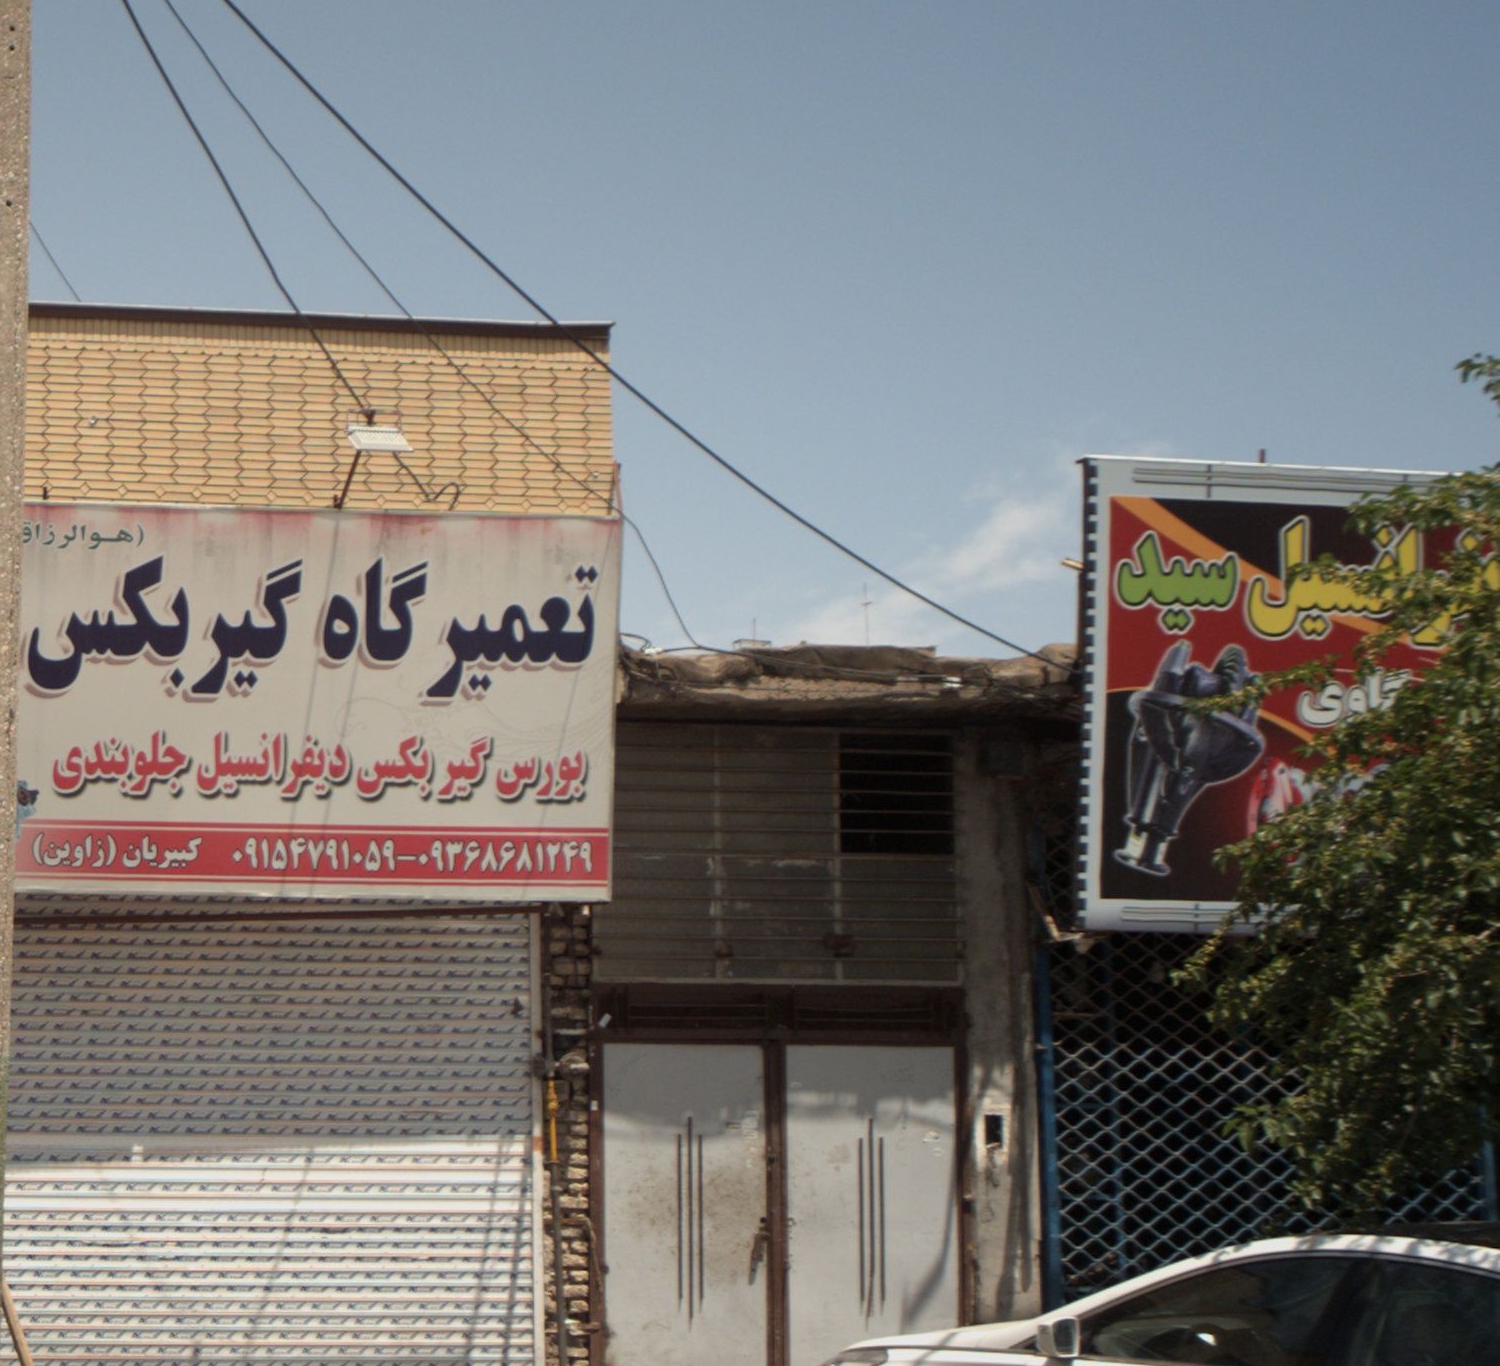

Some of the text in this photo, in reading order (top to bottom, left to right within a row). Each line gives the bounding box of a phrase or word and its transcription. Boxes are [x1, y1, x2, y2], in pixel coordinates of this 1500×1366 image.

[1114, 530, 1239, 635] سید
[27, 555, 302, 695] گیربکس
[52, 729, 188, 794] جلوبندی
[196, 730, 349, 797] دیفرانسیل
[495, 749, 585, 799] بورس
[121, 834, 203, 870] کبیریان
